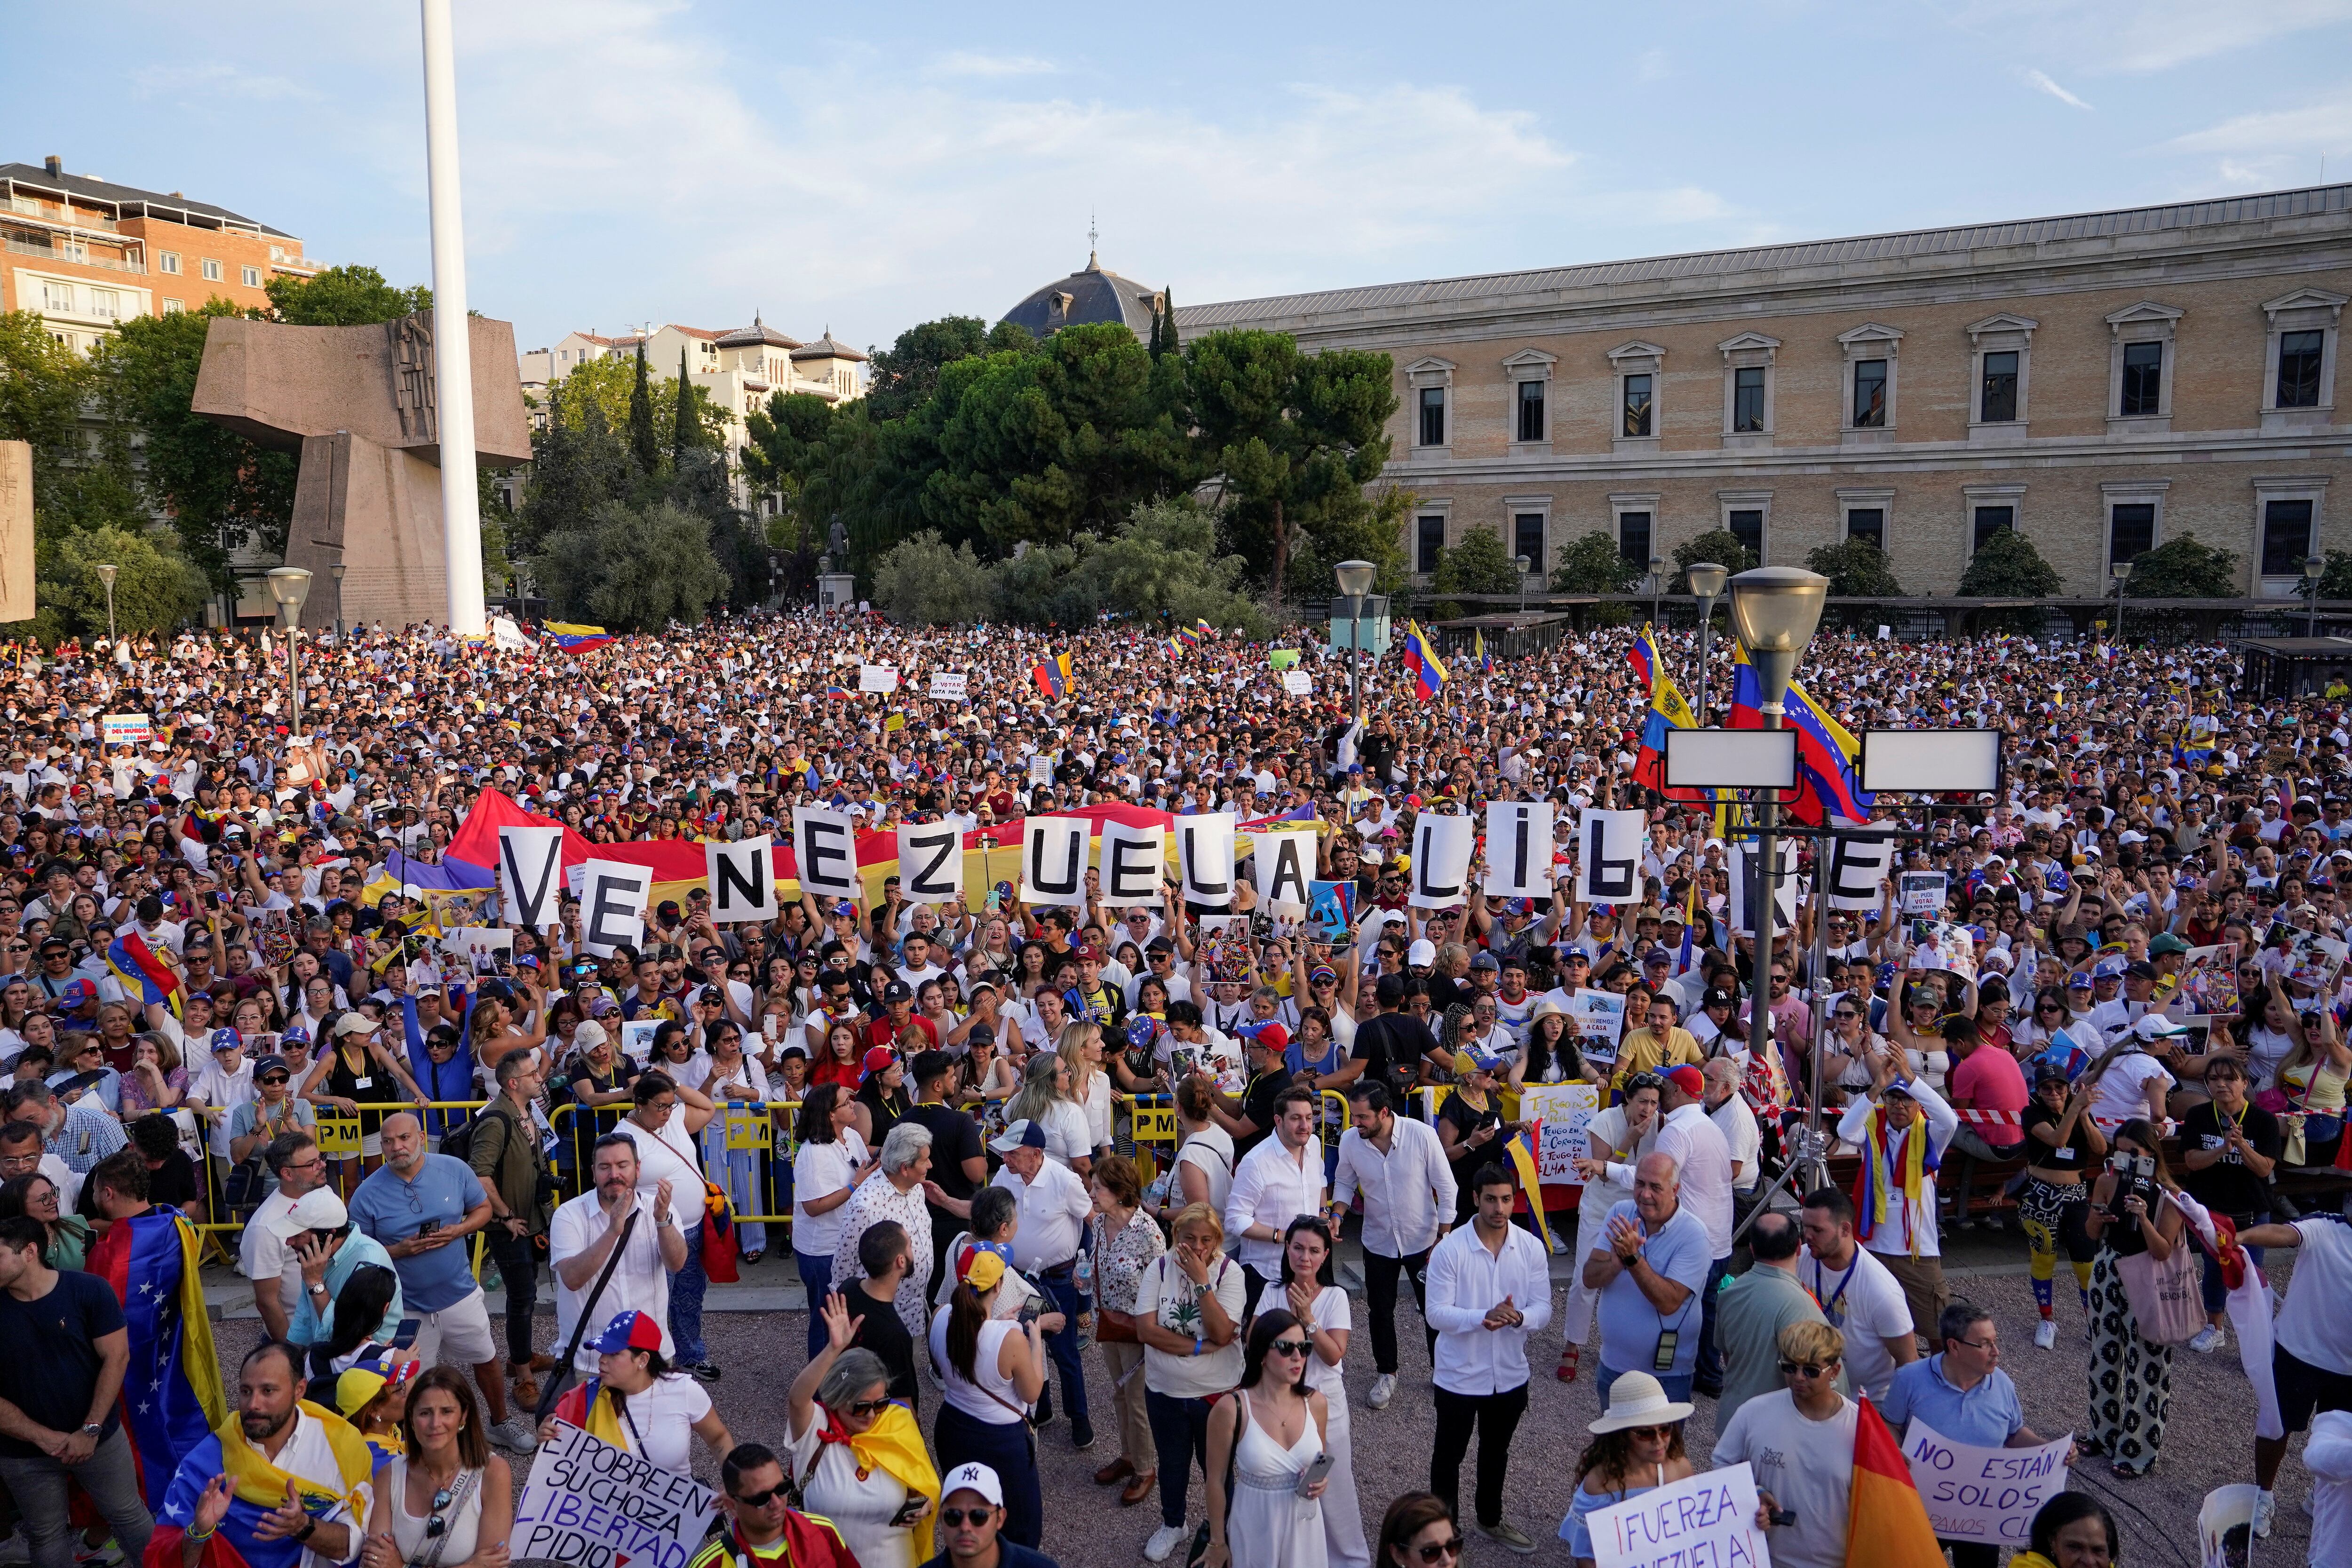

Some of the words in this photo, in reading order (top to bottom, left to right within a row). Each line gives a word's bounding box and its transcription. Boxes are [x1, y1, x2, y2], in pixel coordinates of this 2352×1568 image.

[499, 632, 526, 647] Paracue
[1717, 990, 1727, 999] NY
[1527, 1095, 1545, 1111] TE
[1544, 1097, 1571, 1111] TENGO
[731, 1123, 769, 1141] PM
[1137, 1115, 1174, 1132] PM
[1542, 1126, 1567, 1136] TENGO
[320, 1125, 358, 1144] PM
[1547, 1151, 1572, 1161] TENGO
[2135, 1177, 2149, 1187] ok
[1914, 1437, 1954, 1470] NO
[1981, 1446, 2058, 1480] ESTÁN
[575, 1435, 669, 1497] POBRE
[663, 1476, 712, 1518] EN
[962, 1466, 979, 1480] NY
[452, 1473, 468, 1496] TOUS
[546, 1460, 591, 1493] SU
[588, 1479, 681, 1540] CHOZA
[516, 1486, 686, 1568] LIBERTAD
[1614, 1484, 1738, 1555] ¡FUERZA
[524, 1525, 618, 1568] PIDIÓ
